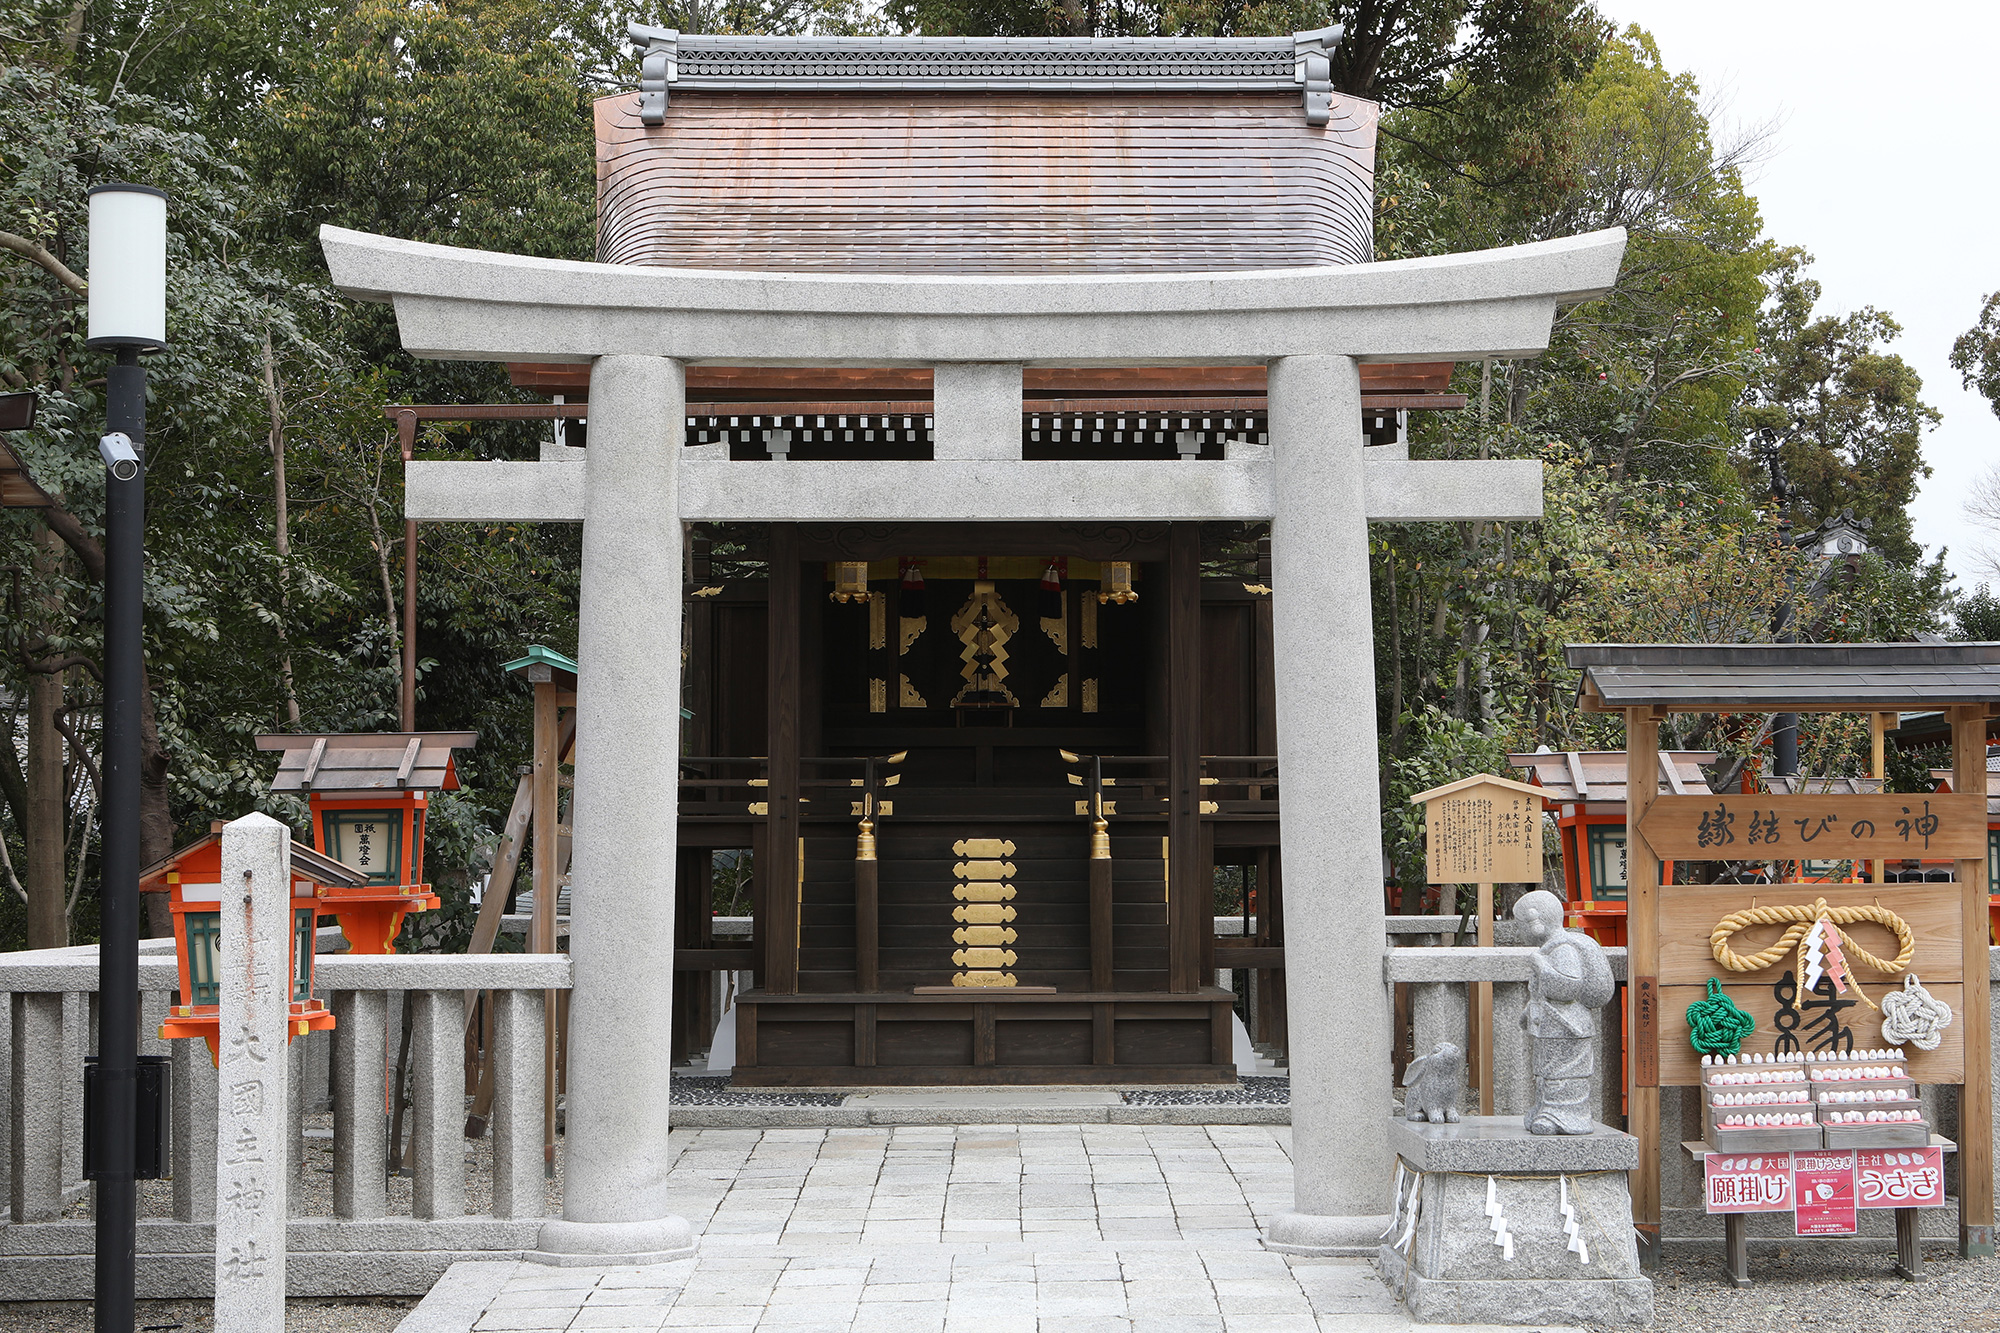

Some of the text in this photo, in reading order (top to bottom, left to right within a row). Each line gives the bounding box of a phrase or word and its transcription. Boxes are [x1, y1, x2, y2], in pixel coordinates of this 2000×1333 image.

[1524, 815, 1533, 849] 大国主社
[1697, 800, 1939, 850] 縁結びの神
[223, 1026, 266, 1284] 大國主神社
[1765, 1157, 1789, 1170] 大国
[1795, 1156, 1852, 1172] 願掛けうさぎ
[1858, 1154, 1883, 1167] 主社
[1711, 1174, 1789, 1205] 願掛け
[1861, 1170, 1937, 1200] うさぎ
